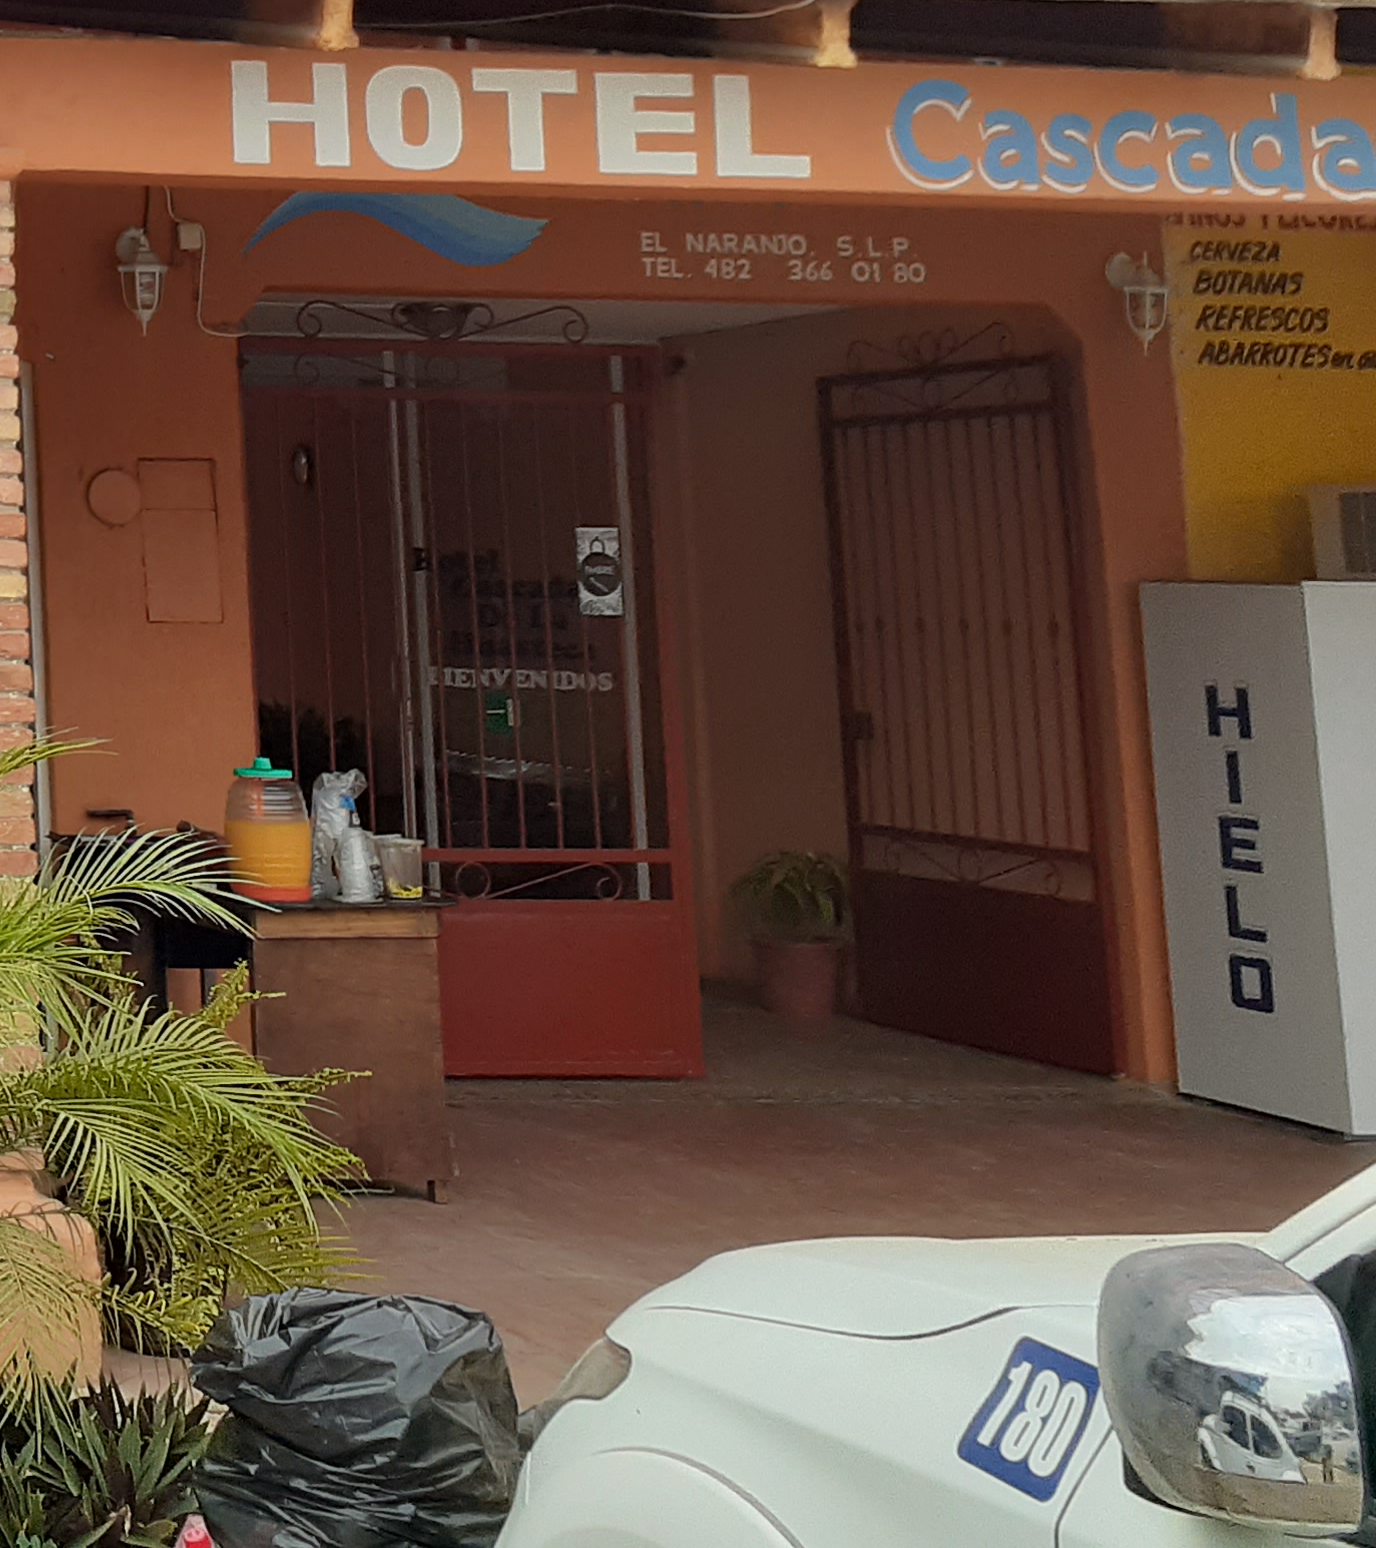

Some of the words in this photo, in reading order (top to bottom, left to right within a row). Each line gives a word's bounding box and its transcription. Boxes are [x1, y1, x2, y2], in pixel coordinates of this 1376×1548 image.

[230, 60, 811, 178] HOTEL
[887, 78, 1376, 203] Cascada
[639, 231, 668, 253] EL
[1190, 240, 1281, 263] CERVEZA
[703, 258, 753, 280] 482
[787, 259, 834, 282] 366
[893, 261, 927, 284] 80
[1192, 270, 1304, 296] BOTANAS
[1195, 304, 1330, 333] REFRESCOS
[1198, 340, 1332, 369] ABARROTES
[1205, 681, 1275, 1013] HIELO
[975, 1360, 1089, 1479] 180
